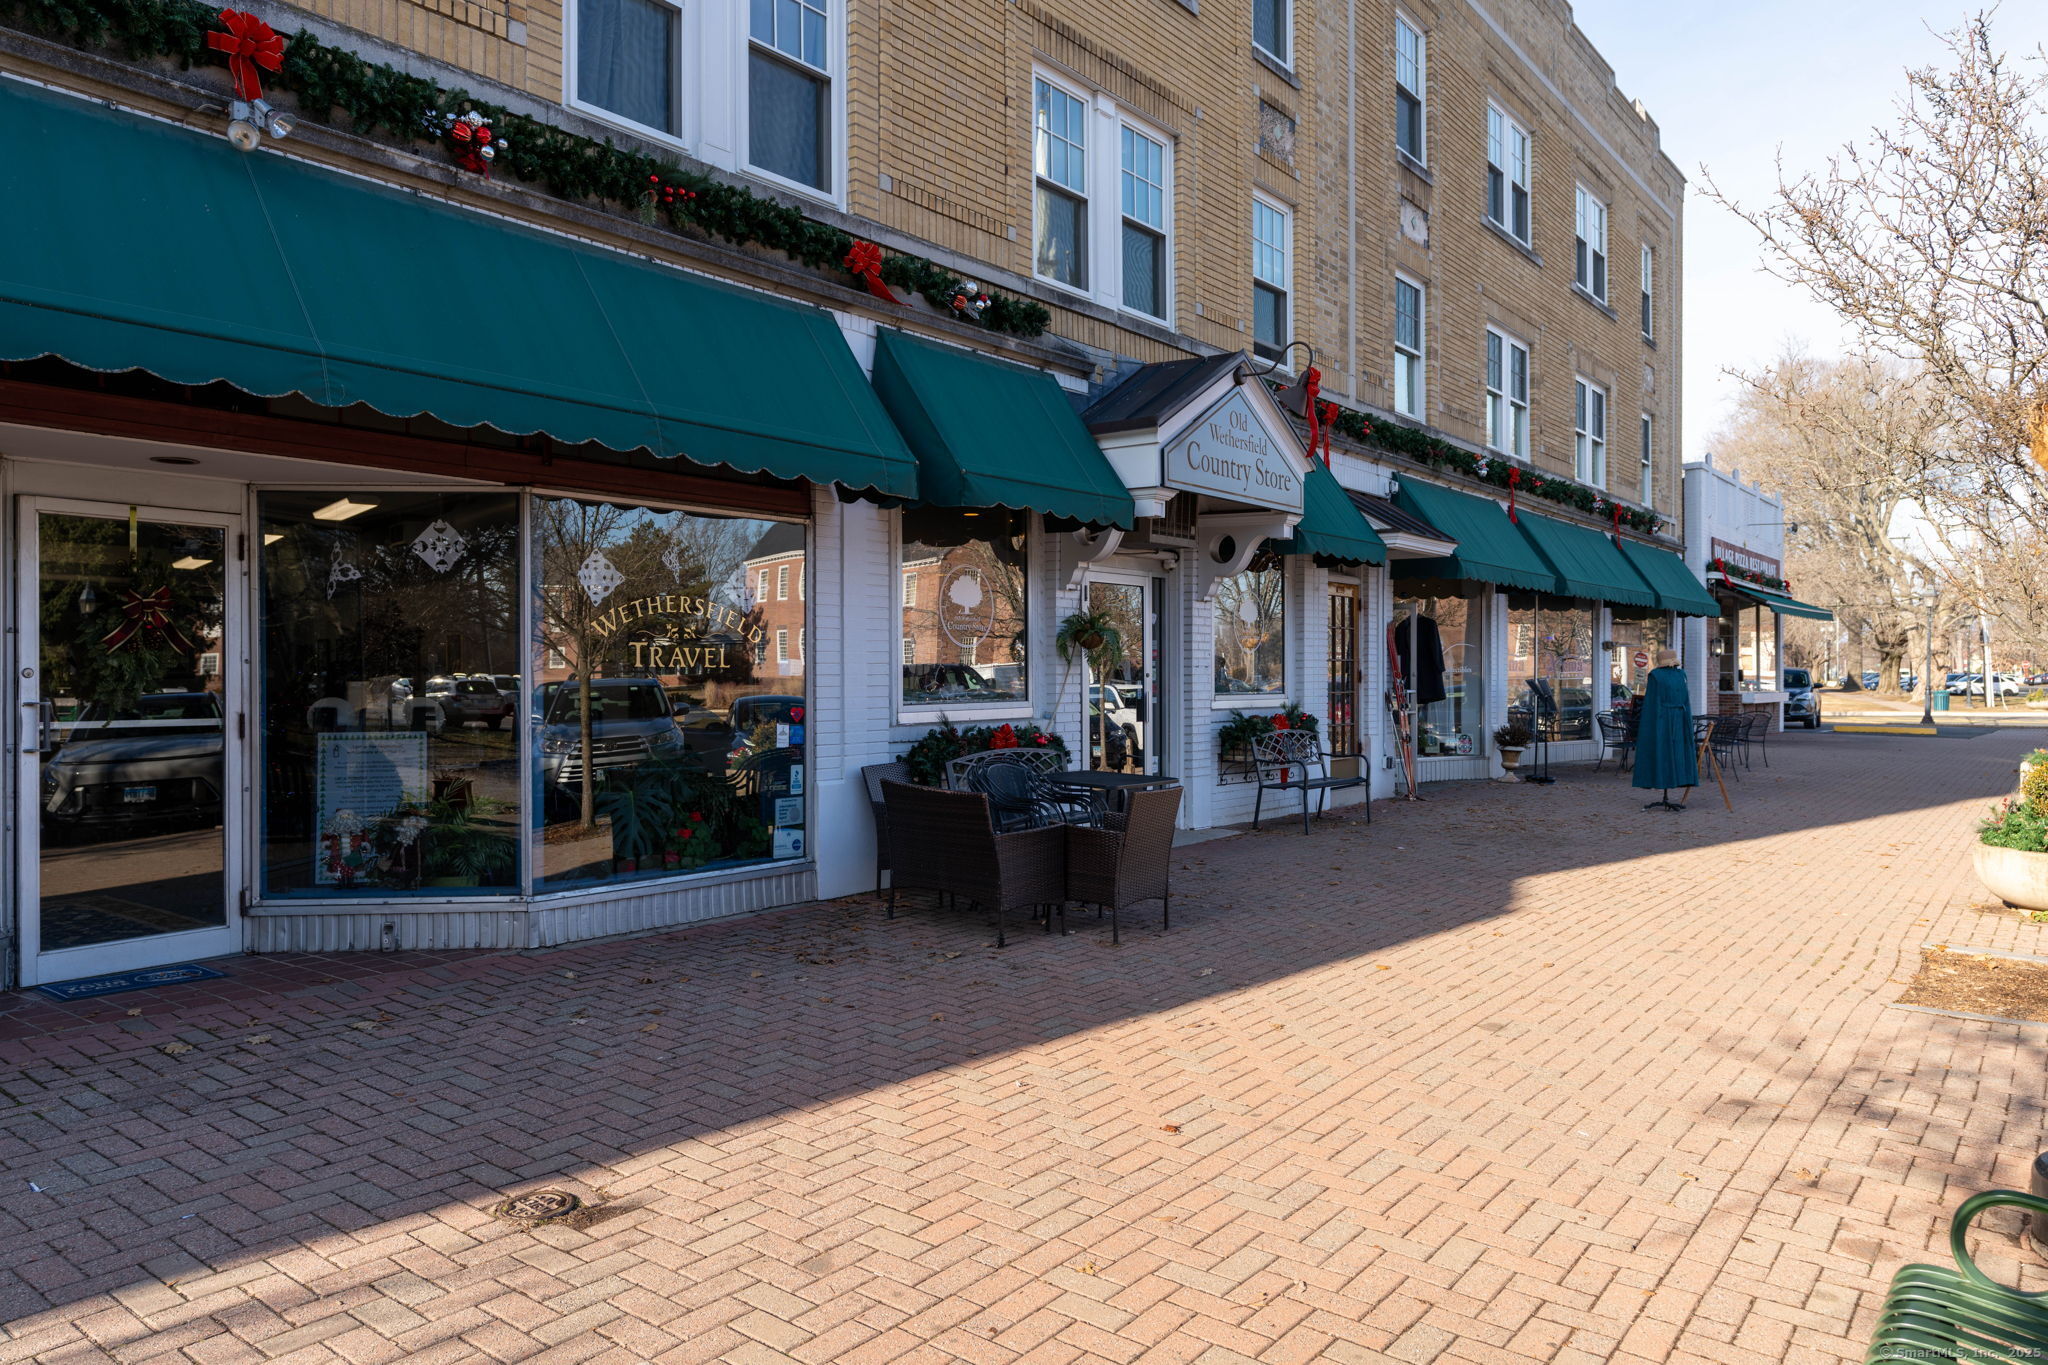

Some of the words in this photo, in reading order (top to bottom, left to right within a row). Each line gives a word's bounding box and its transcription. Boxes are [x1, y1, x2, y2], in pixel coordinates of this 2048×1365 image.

[1230, 411, 1248, 432] Old
[1210, 423, 1268, 456] Wethersfield
[1187, 441, 1251, 492] Country
[1255, 458, 1291, 492] Store
[591, 595, 763, 643] WETHERSFIELD
[628, 642, 731, 669] TRAVEL
